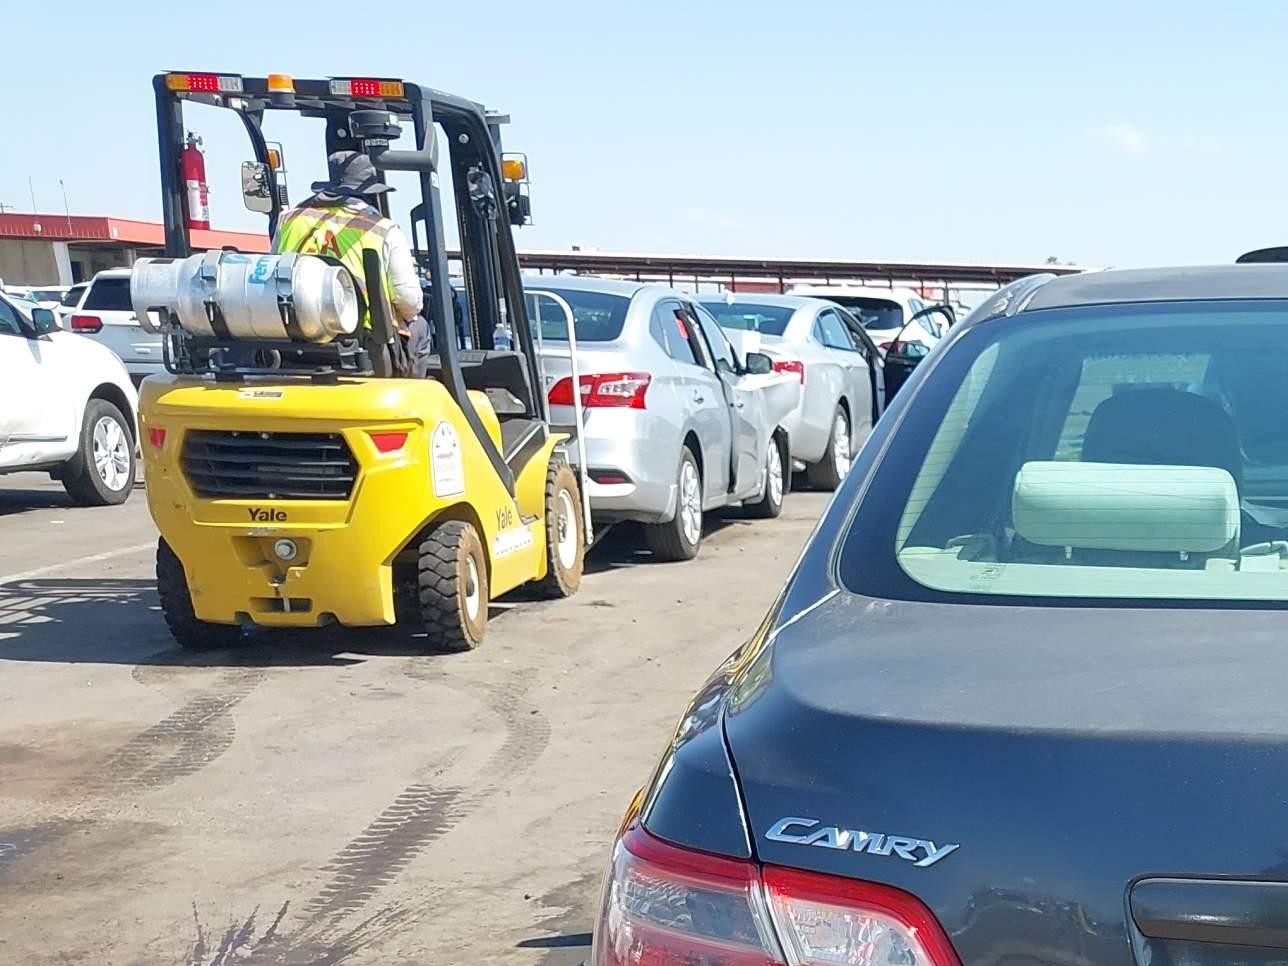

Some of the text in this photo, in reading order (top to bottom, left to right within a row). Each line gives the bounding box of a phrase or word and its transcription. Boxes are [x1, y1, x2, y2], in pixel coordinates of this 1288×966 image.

[247, 507, 288, 522] Yale
[495, 506, 513, 531] Yale
[764, 816, 960, 868] CAMRY
